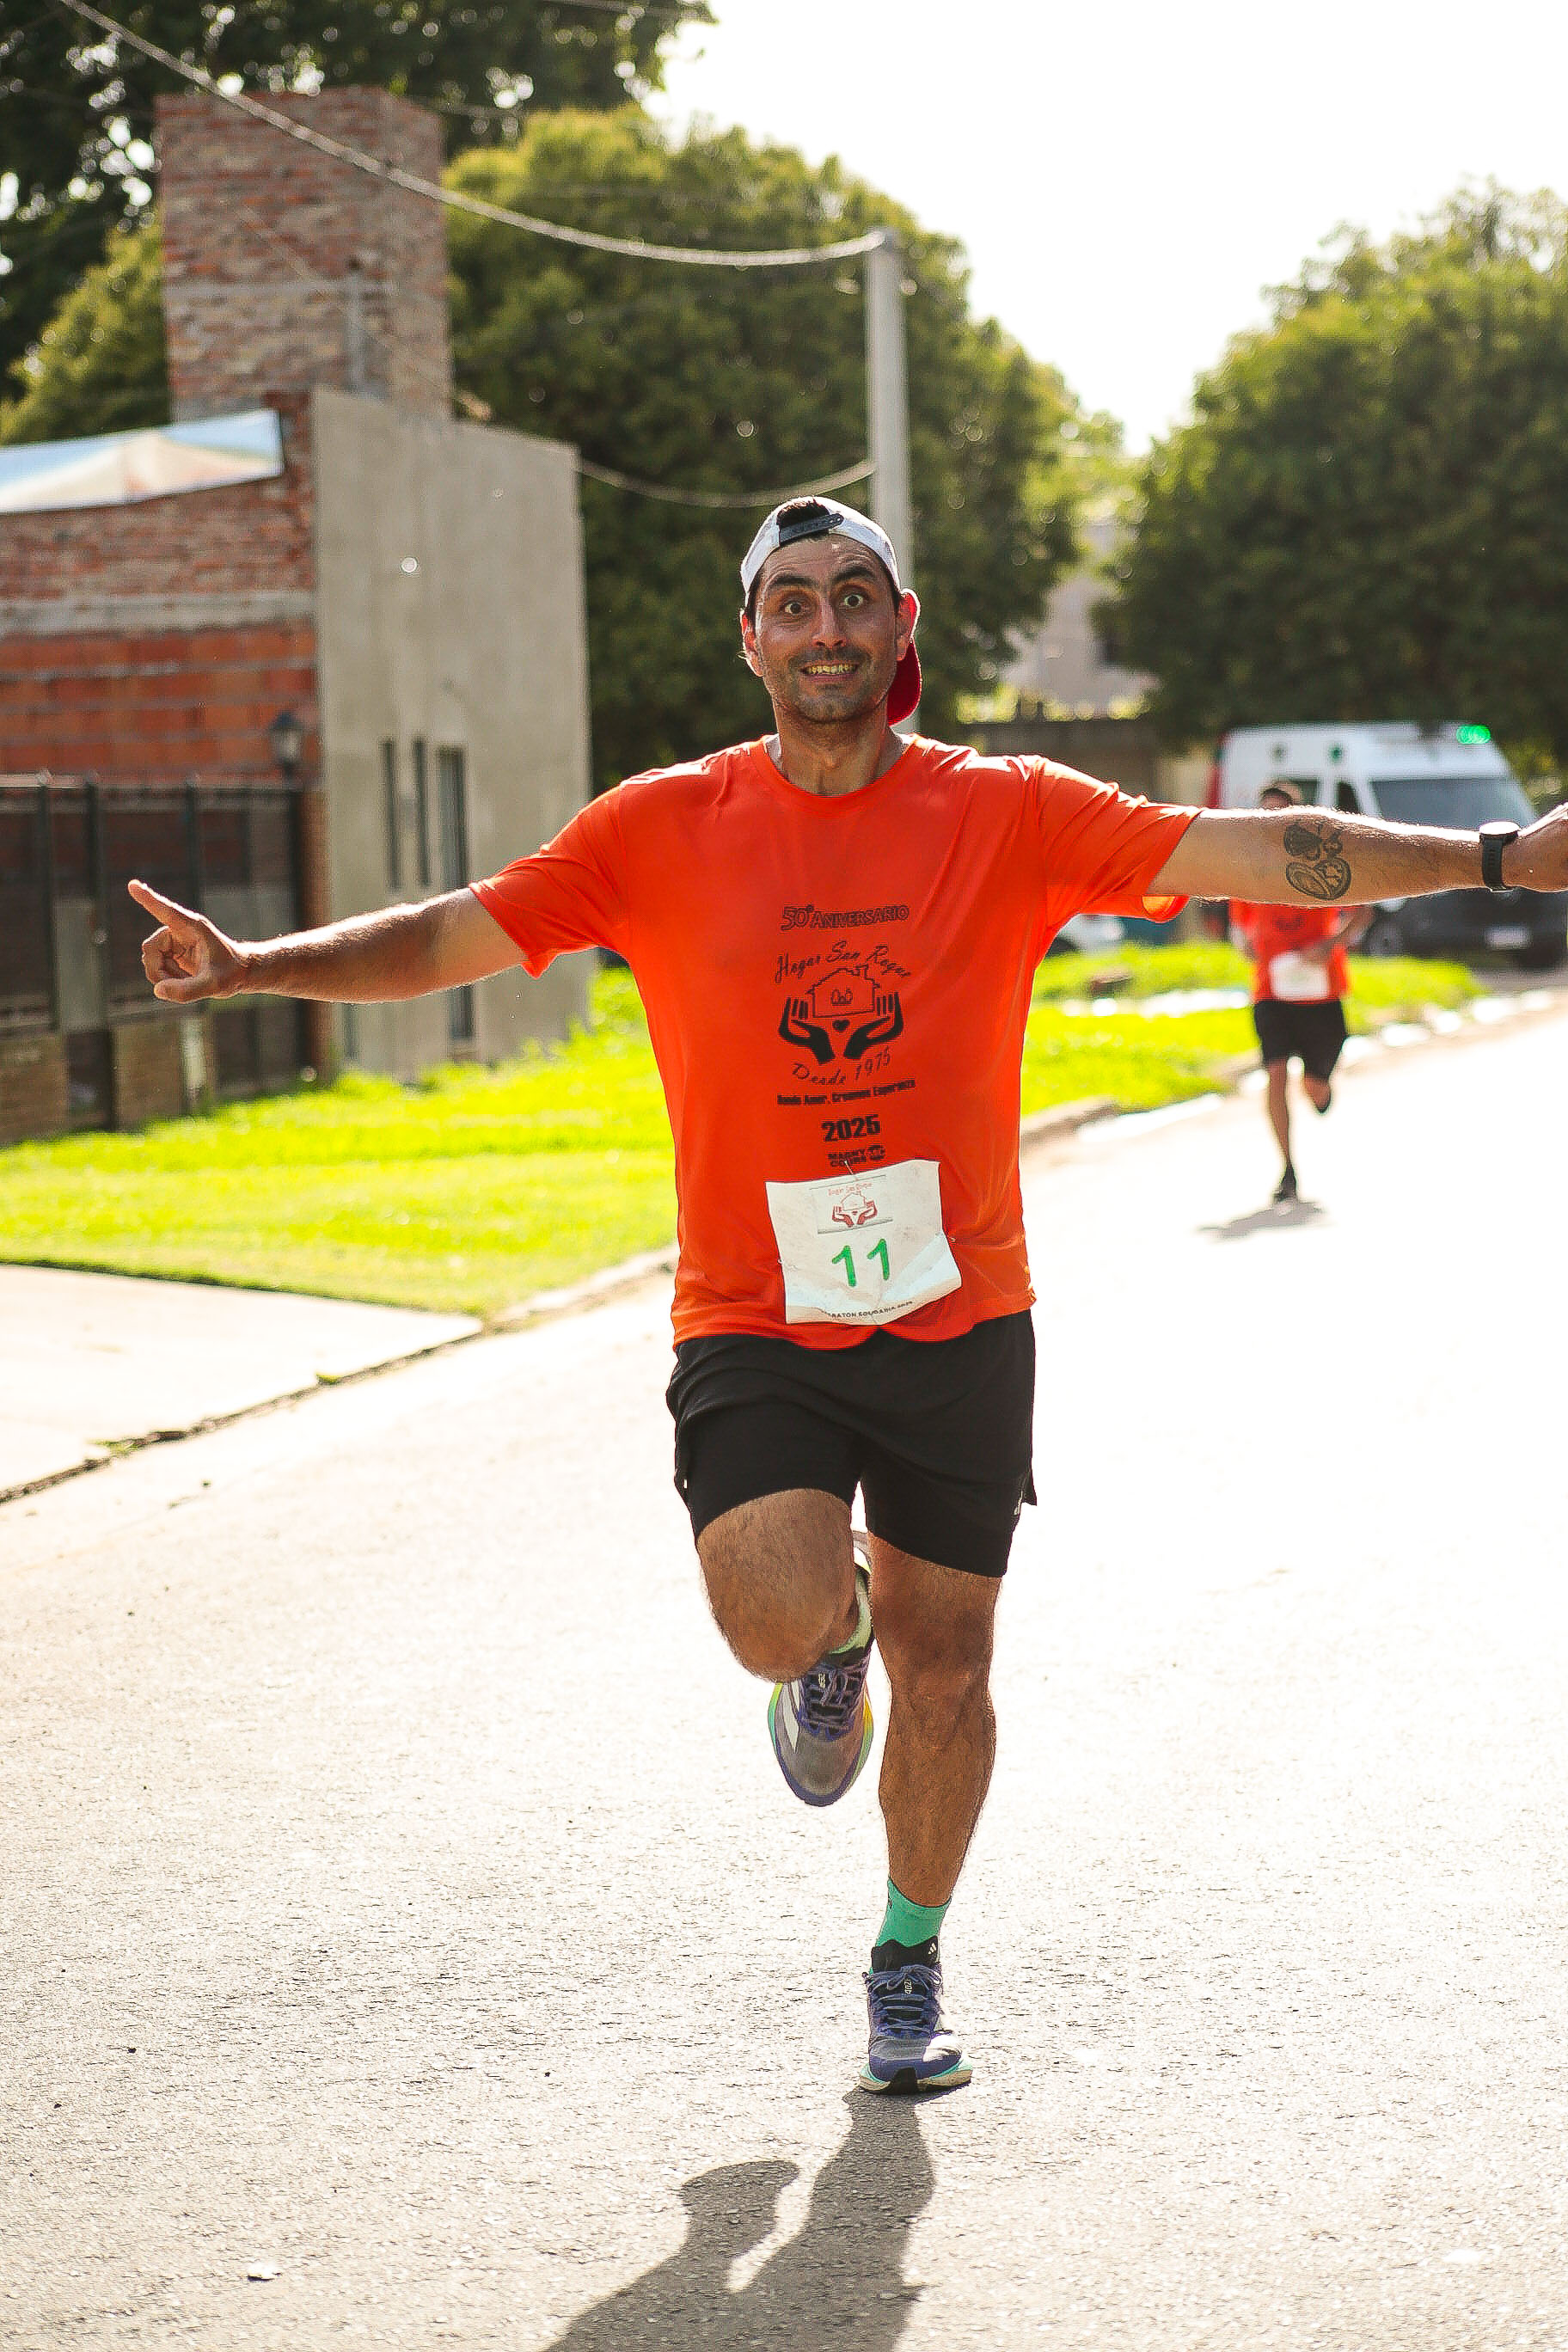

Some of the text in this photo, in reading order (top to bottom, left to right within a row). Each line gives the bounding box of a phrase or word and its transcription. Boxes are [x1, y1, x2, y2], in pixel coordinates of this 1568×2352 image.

[811, 904, 910, 928] ANIVERSARIO
[775, 940, 911, 983] Hogar San Roque
[793, 1045, 891, 1085] Desde 1975
[821, 1114, 881, 1142] 2025
[831, 1238, 891, 1288] 11
